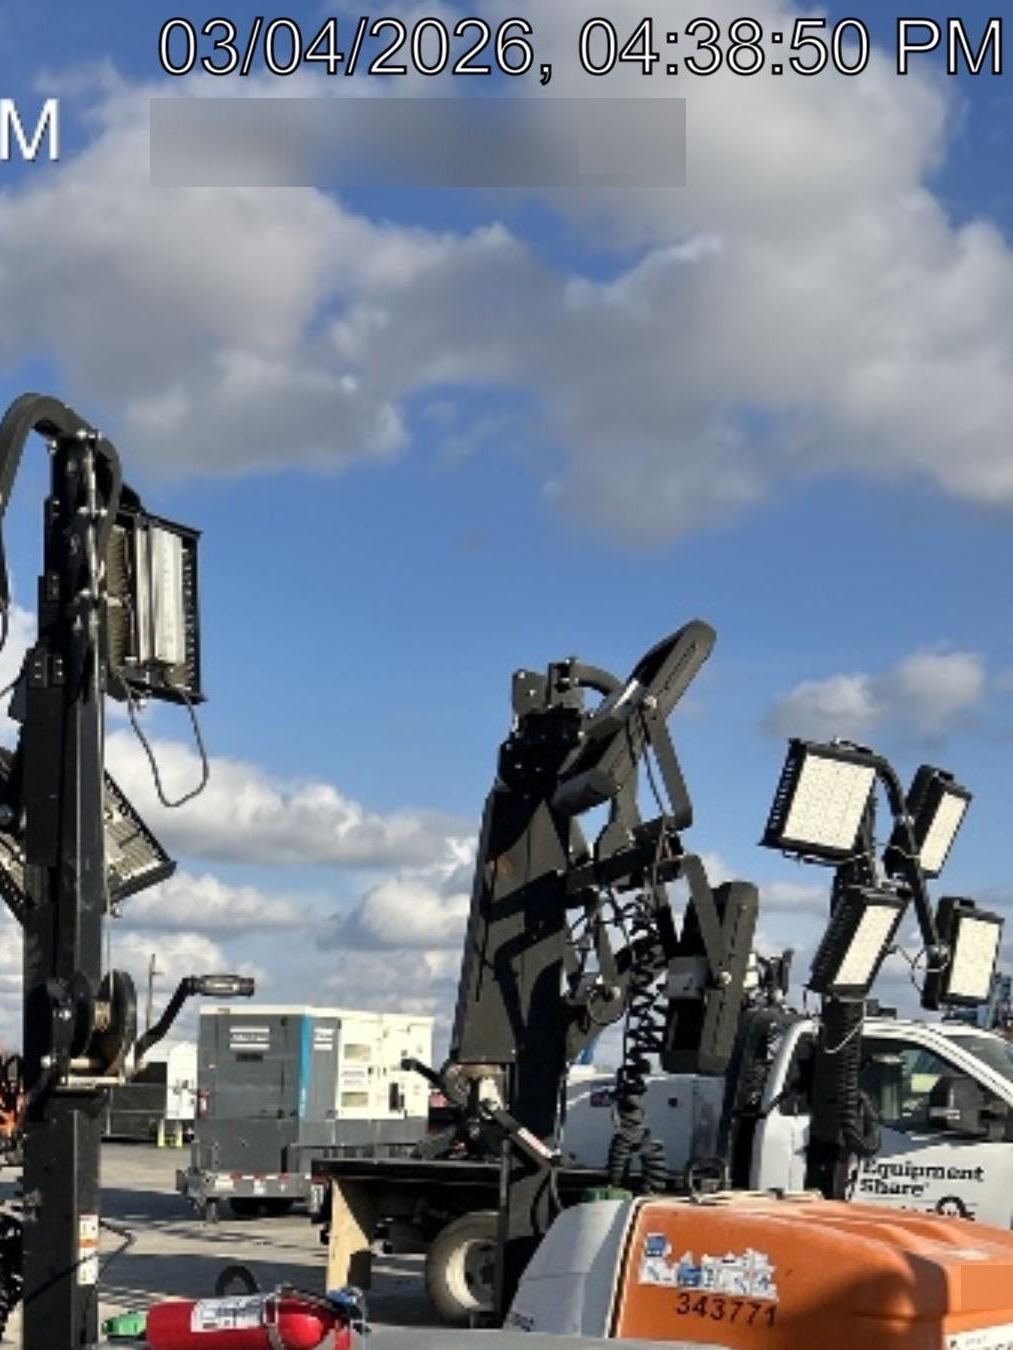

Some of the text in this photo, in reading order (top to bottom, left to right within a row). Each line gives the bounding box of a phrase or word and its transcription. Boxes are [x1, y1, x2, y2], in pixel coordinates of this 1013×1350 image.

[862, 1160, 985, 1182] Equipment
[859, 1178, 924, 1198] Share
[675, 1292, 778, 1328] 343771
